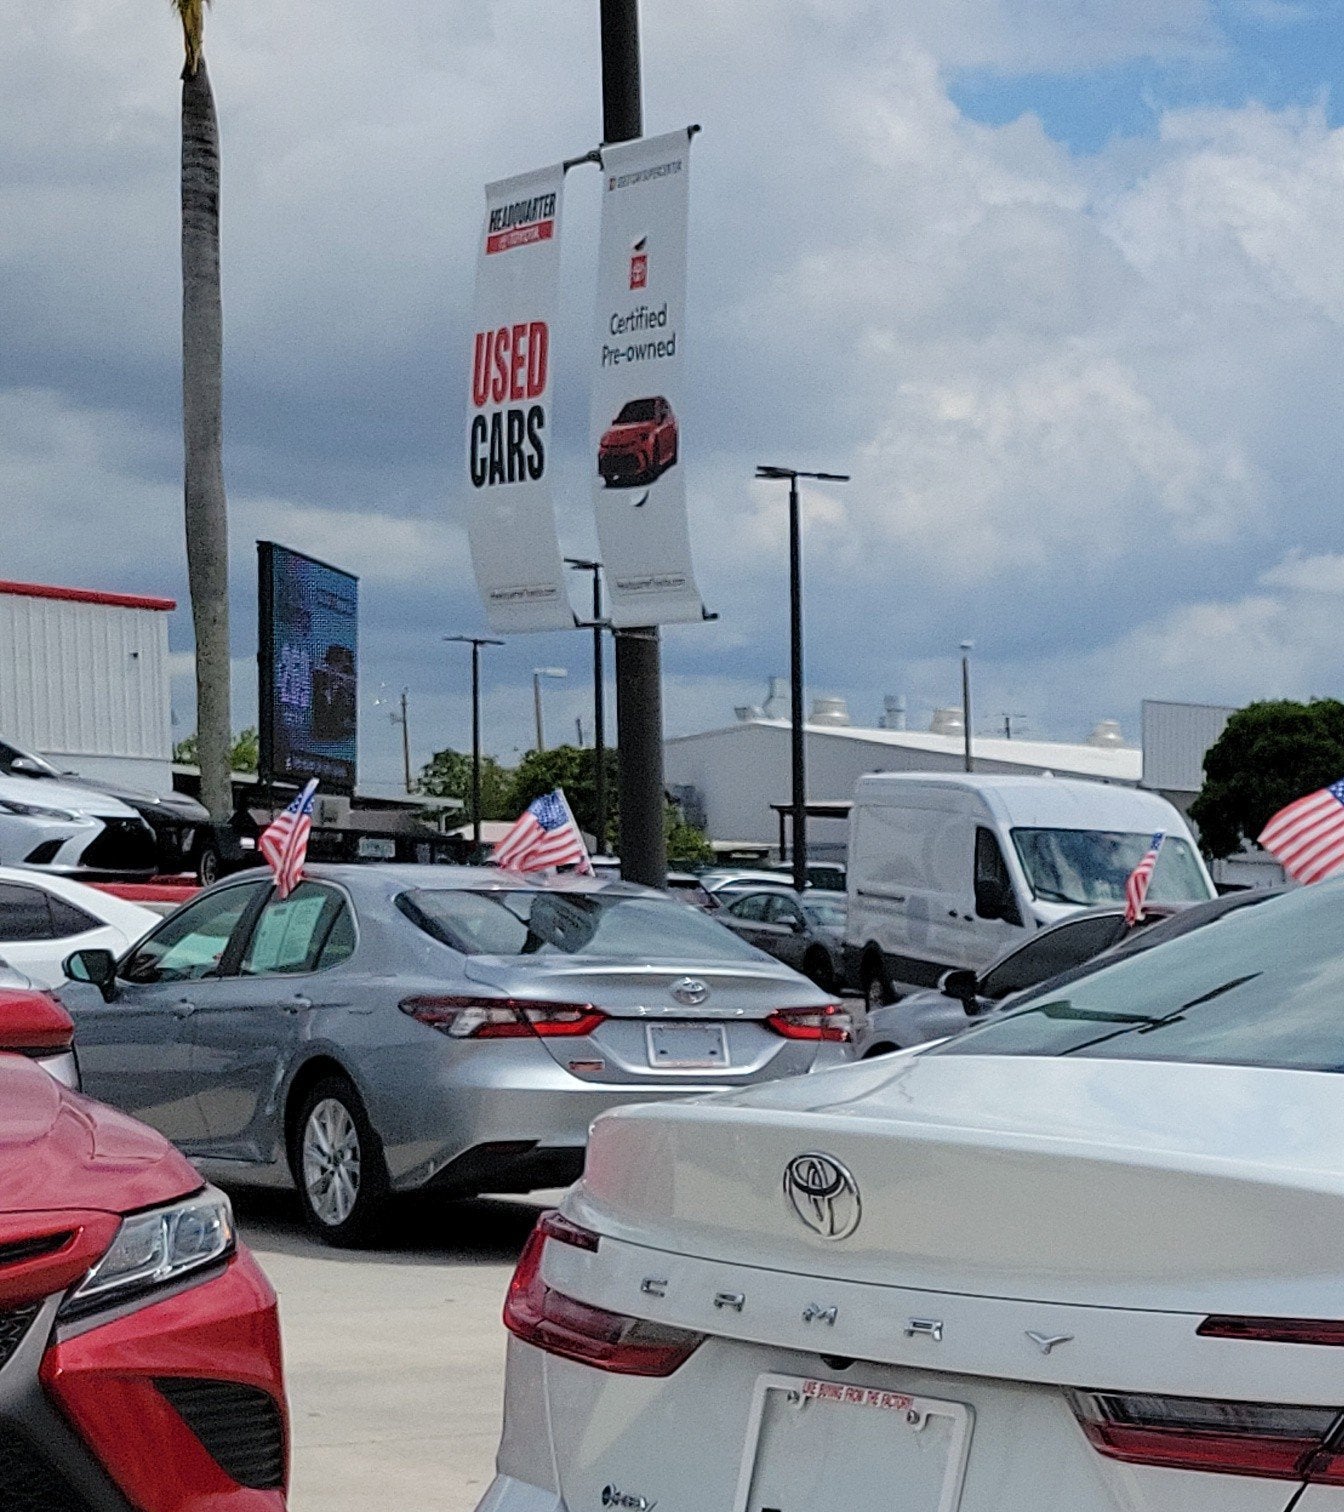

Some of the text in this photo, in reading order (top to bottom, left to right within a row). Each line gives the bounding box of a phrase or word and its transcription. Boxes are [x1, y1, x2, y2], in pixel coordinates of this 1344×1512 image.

[602, 333, 677, 368] Pre-owned
[610, 303, 668, 336] Certified
[472, 321, 548, 408] USED
[470, 405, 545, 488] CARS
[640, 1277, 1075, 1355] CAMRY
